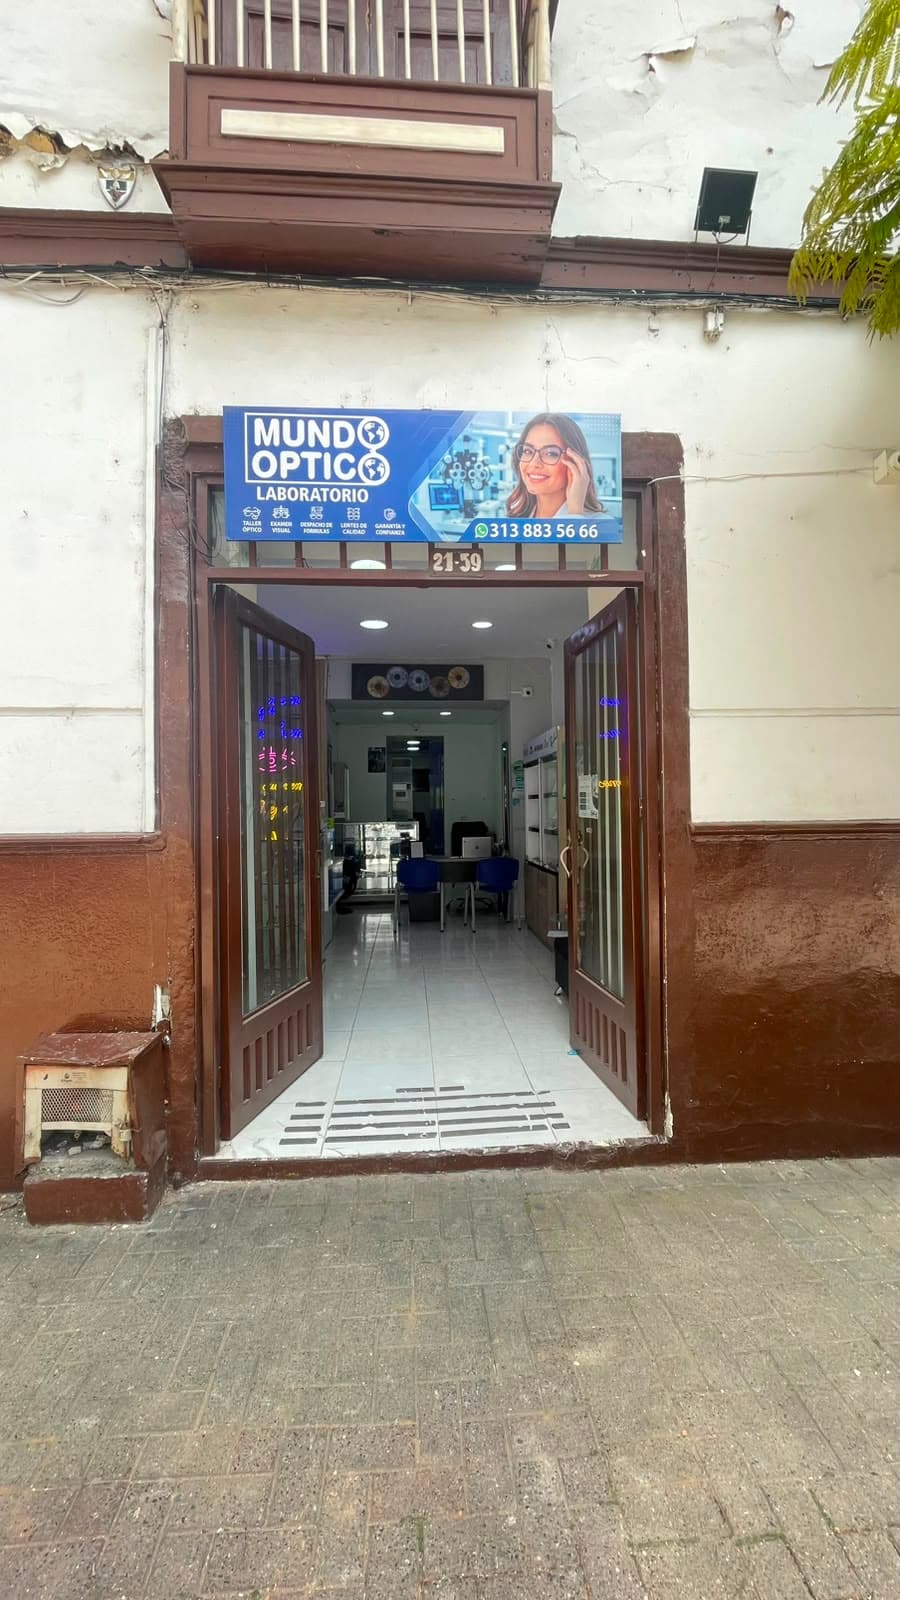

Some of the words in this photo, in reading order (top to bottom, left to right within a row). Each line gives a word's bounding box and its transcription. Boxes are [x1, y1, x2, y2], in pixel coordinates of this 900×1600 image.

[254, 417, 390, 450] MUNDO
[252, 450, 390, 485] OPTICO
[256, 486, 369, 503] LABORATORIO
[490, 523, 519, 538] 313
[523, 524, 552, 538] 883
[556, 524, 576, 538] 56
[579, 524, 598, 538] 66
[432, 552, 482, 572] 21-59
